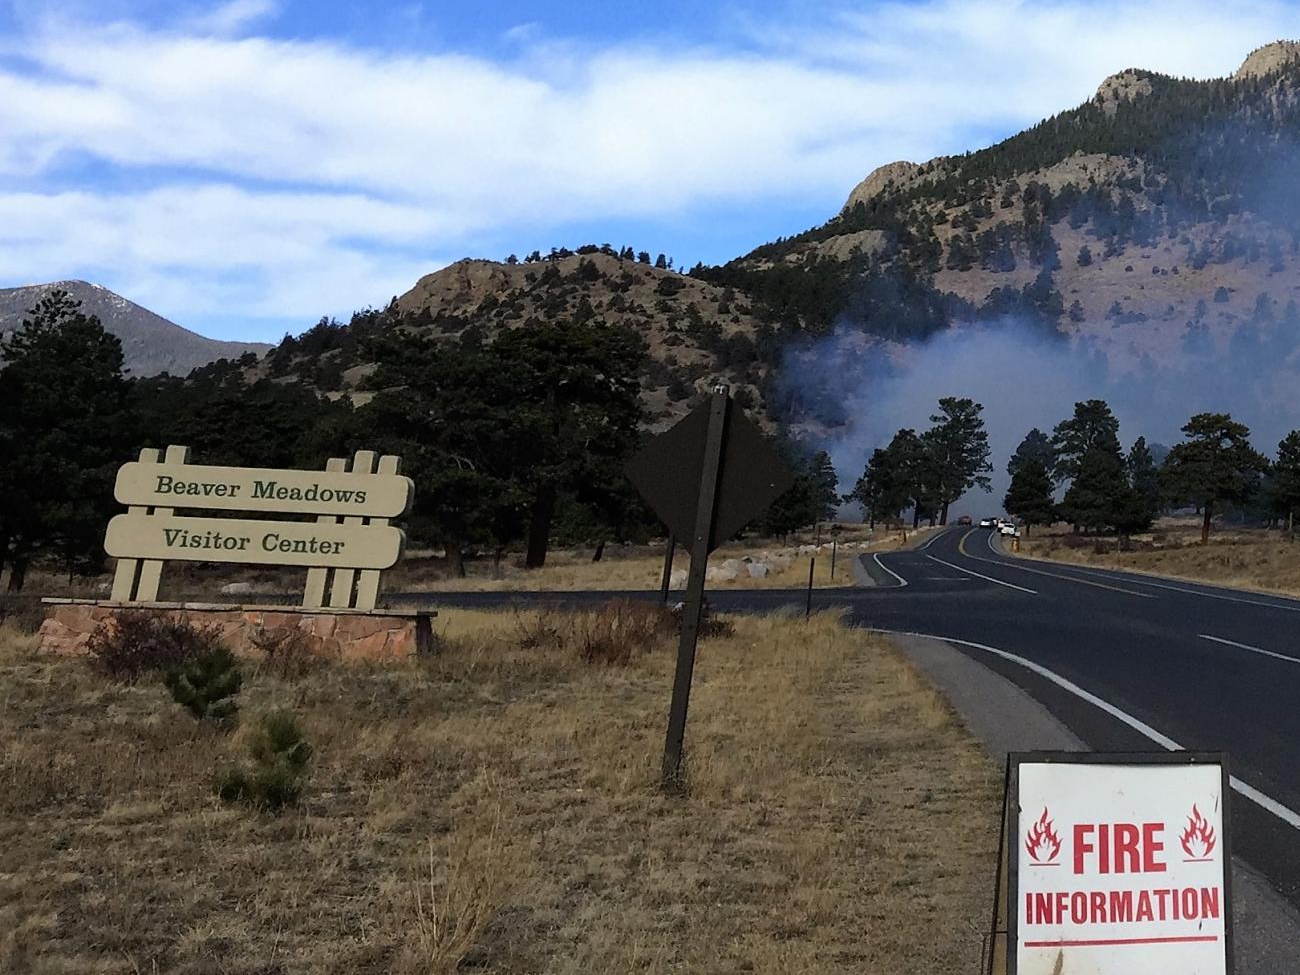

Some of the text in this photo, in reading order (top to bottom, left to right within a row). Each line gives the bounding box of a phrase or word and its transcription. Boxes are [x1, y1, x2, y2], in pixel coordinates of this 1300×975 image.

[154, 476, 367, 504] Beaver Meadows
[163, 528, 345, 555] Visitor Center
[1073, 822, 1167, 875] FIRE
[1026, 887, 1220, 925] INFORMATION
